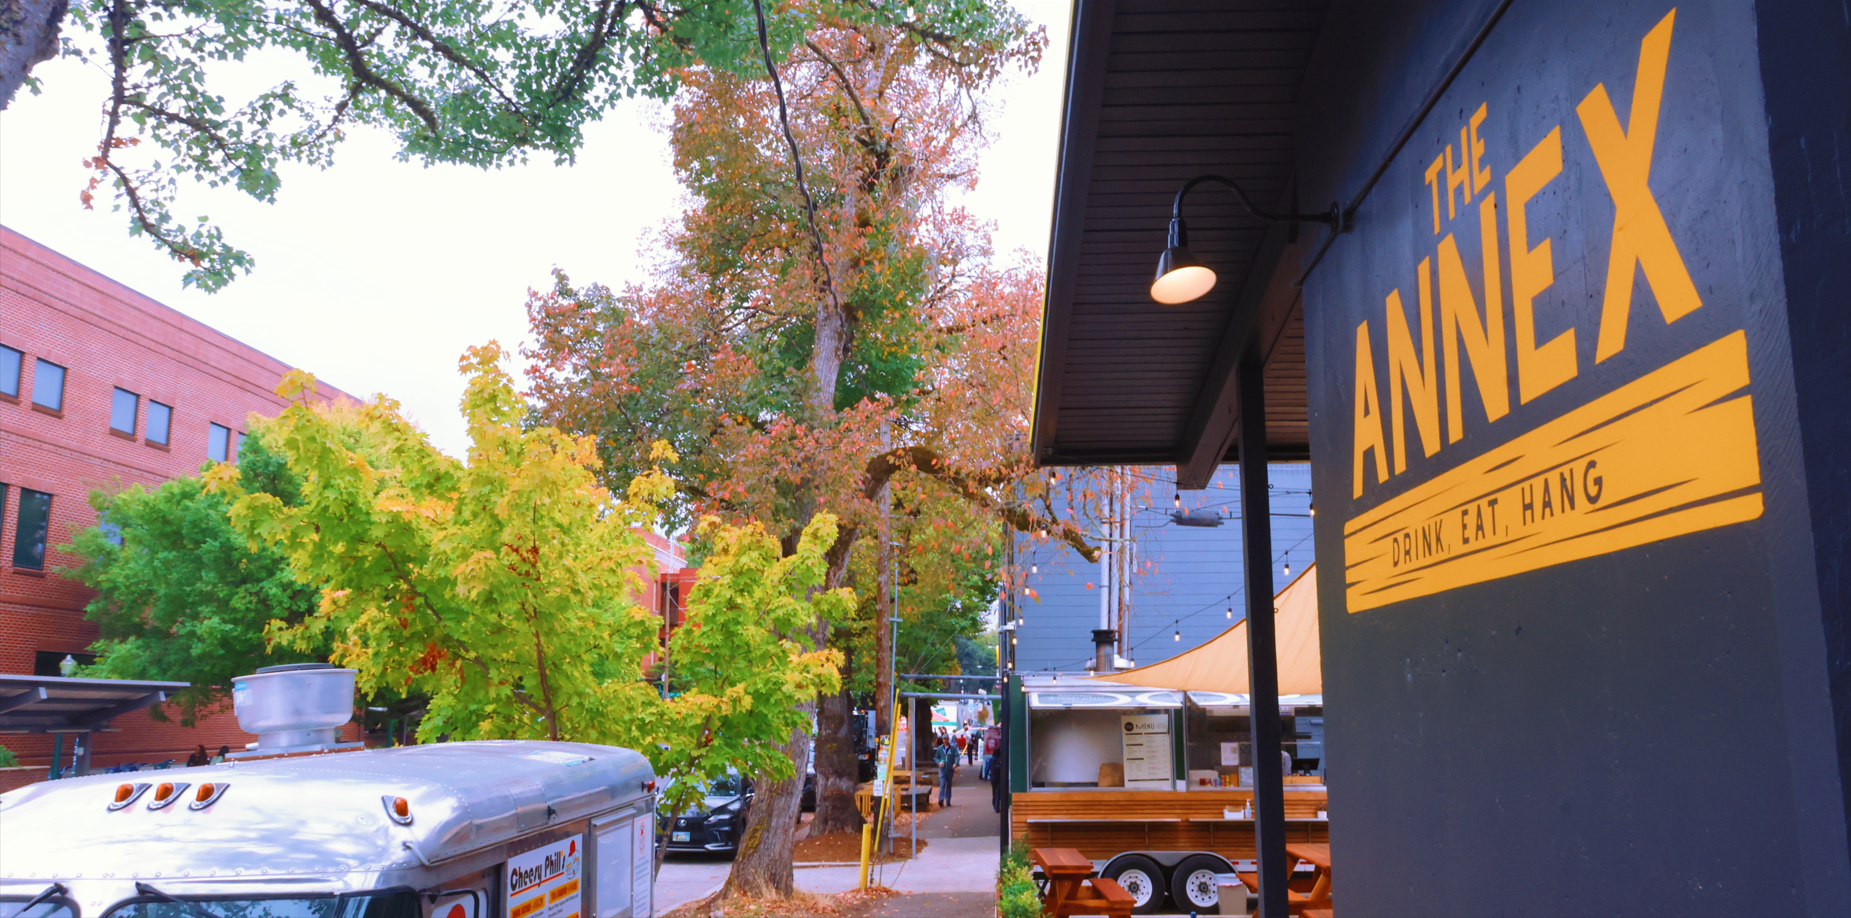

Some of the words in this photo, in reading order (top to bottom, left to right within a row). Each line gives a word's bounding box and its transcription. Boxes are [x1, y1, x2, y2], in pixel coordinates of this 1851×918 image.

[1425, 102, 1491, 235] THE
[1353, 7, 1702, 499] ANNEX
[1392, 519, 1450, 568] DRINK,
[1461, 497, 1508, 545] EAT,
[1521, 459, 1603, 526] HANG
